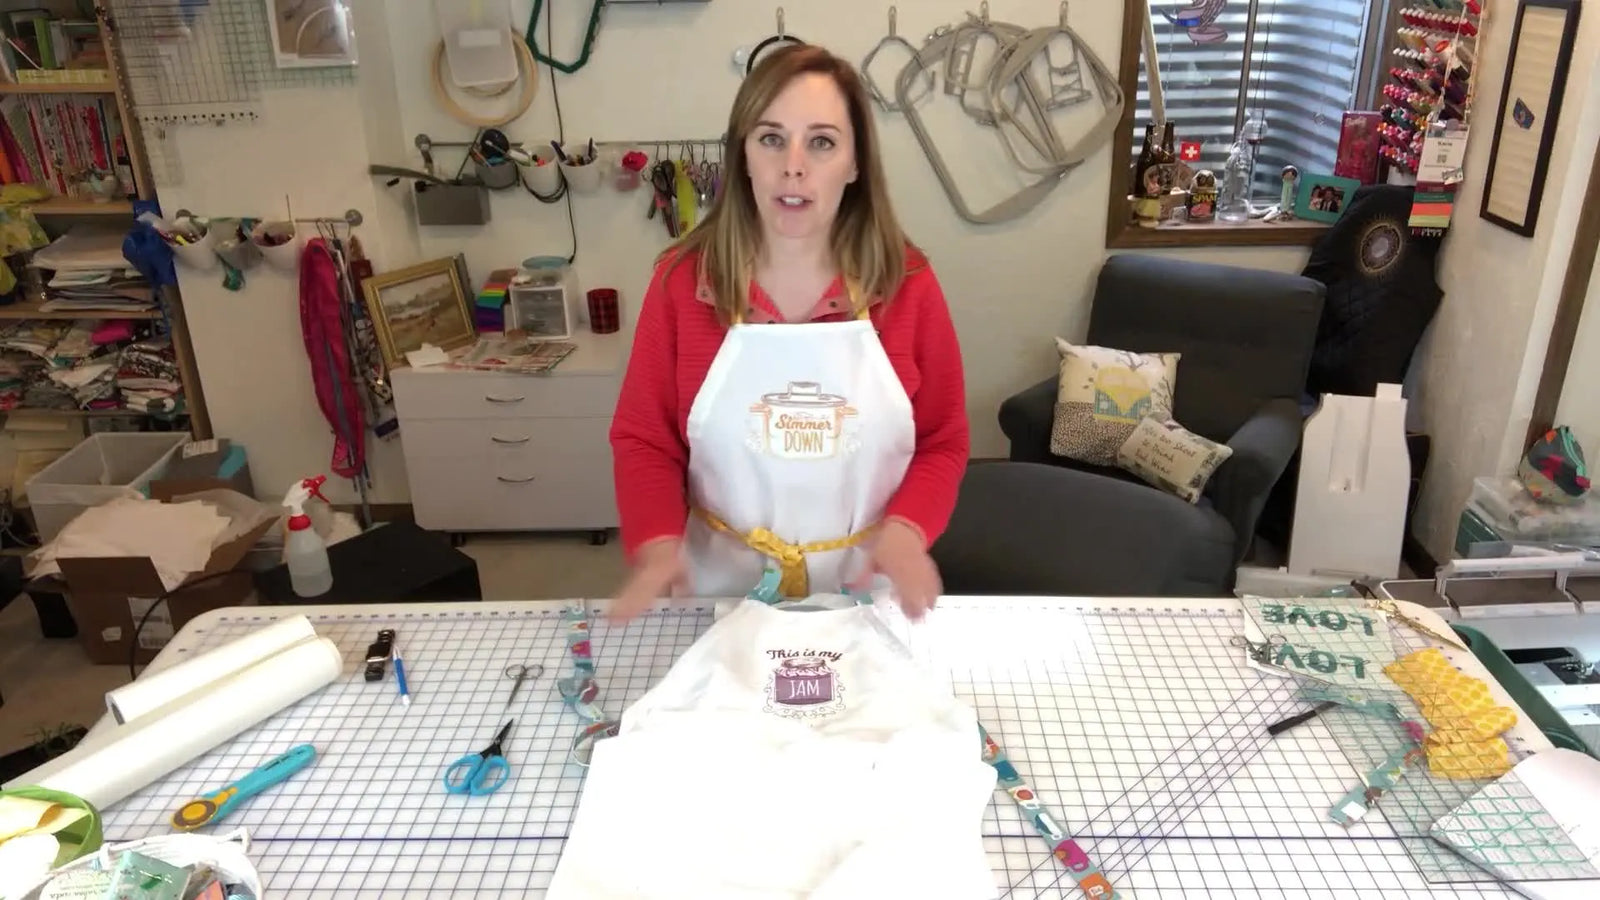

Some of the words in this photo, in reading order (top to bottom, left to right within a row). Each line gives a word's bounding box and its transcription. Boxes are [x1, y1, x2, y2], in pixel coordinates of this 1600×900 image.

[775, 413, 833, 431] Simmer
[784, 430, 824, 453] DOWN
[1261, 603, 1375, 637] LOVE
[766, 648, 800, 660] This
[803, 648, 816, 659] is
[818, 650, 843, 662] my
[788, 679, 820, 700] JAM
